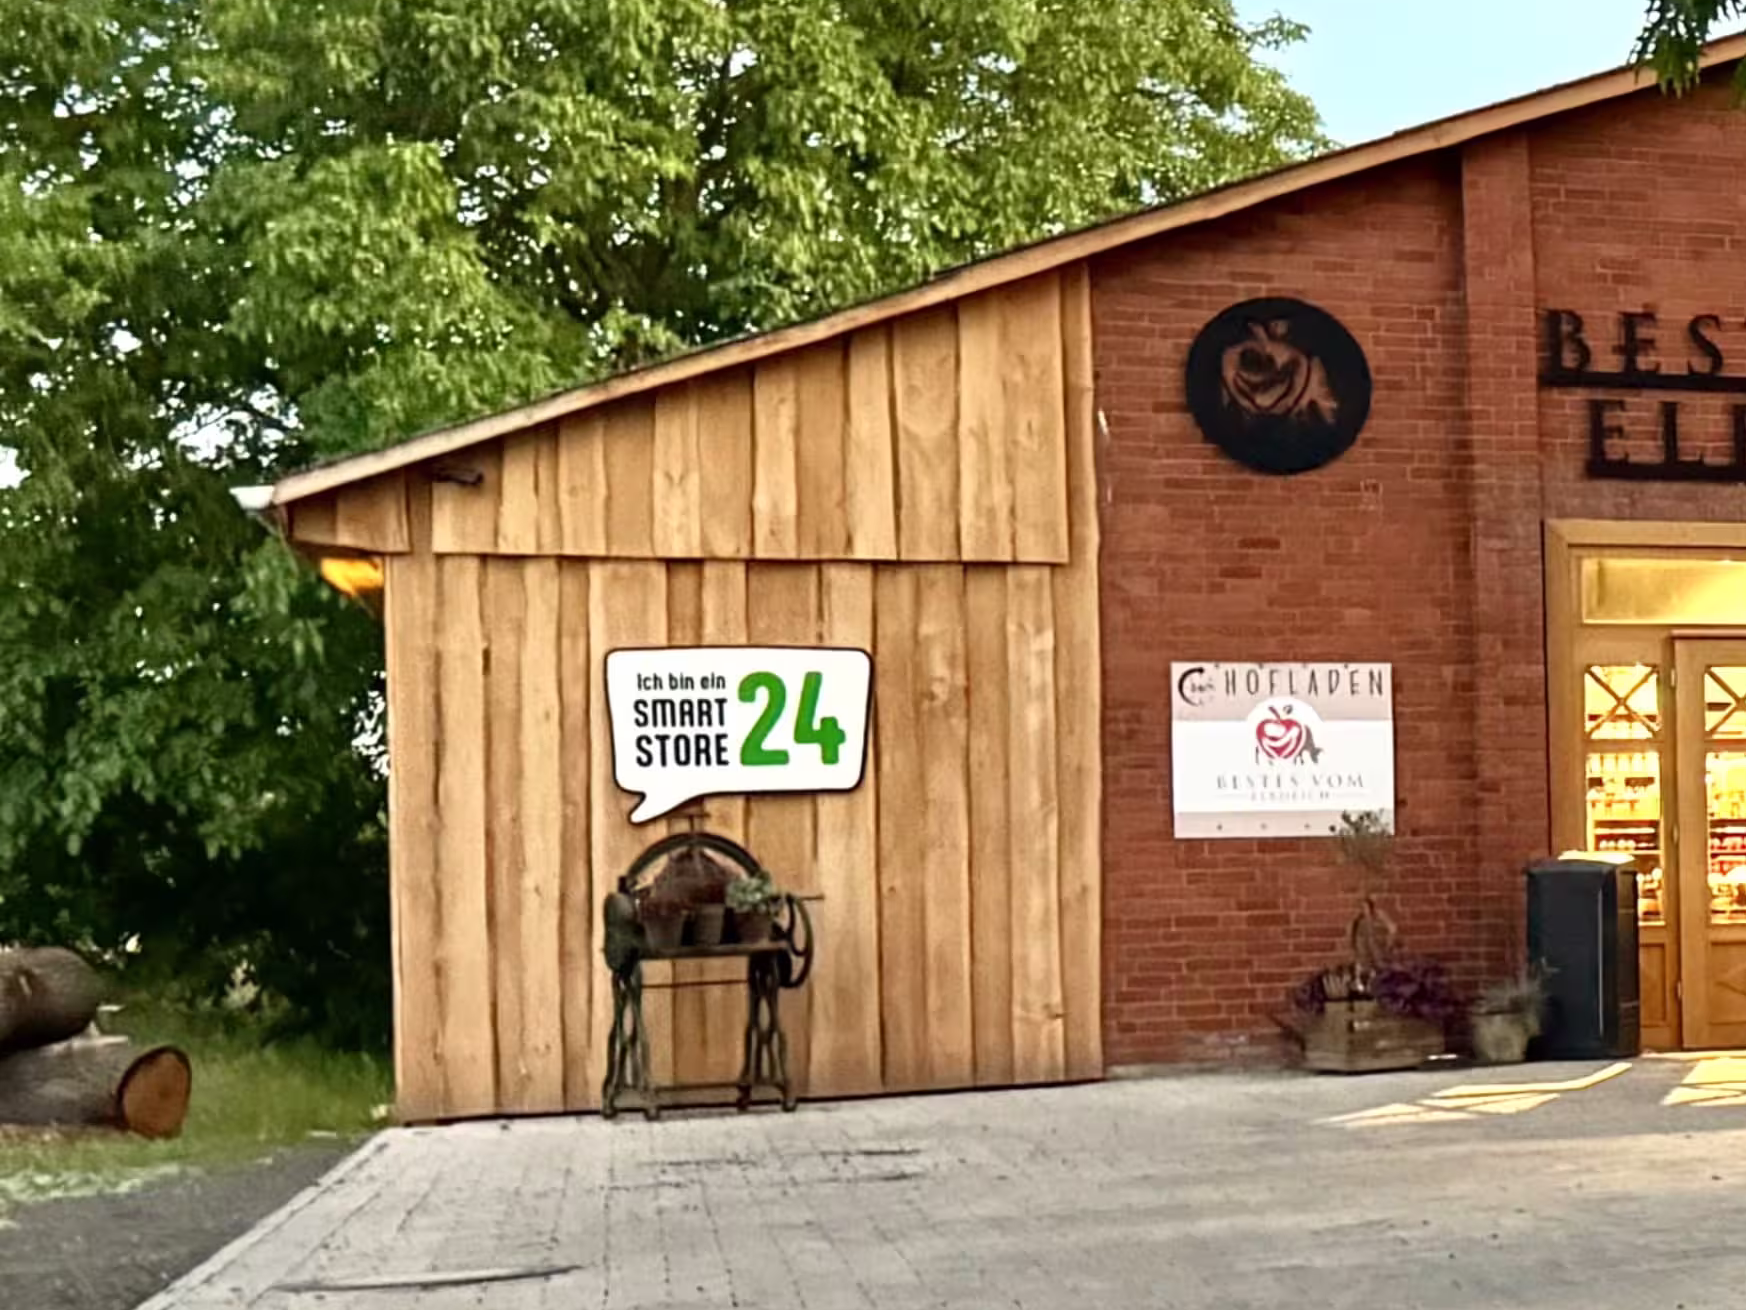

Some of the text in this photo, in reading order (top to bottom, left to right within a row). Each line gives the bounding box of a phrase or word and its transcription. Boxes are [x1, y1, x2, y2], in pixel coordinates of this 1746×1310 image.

[636, 671, 726, 692] Ich bin ein
[1224, 668, 1384, 697] HOFLADEN
[633, 697, 728, 728] SMART
[737, 670, 847, 767] 24
[635, 733, 730, 768] STORE
